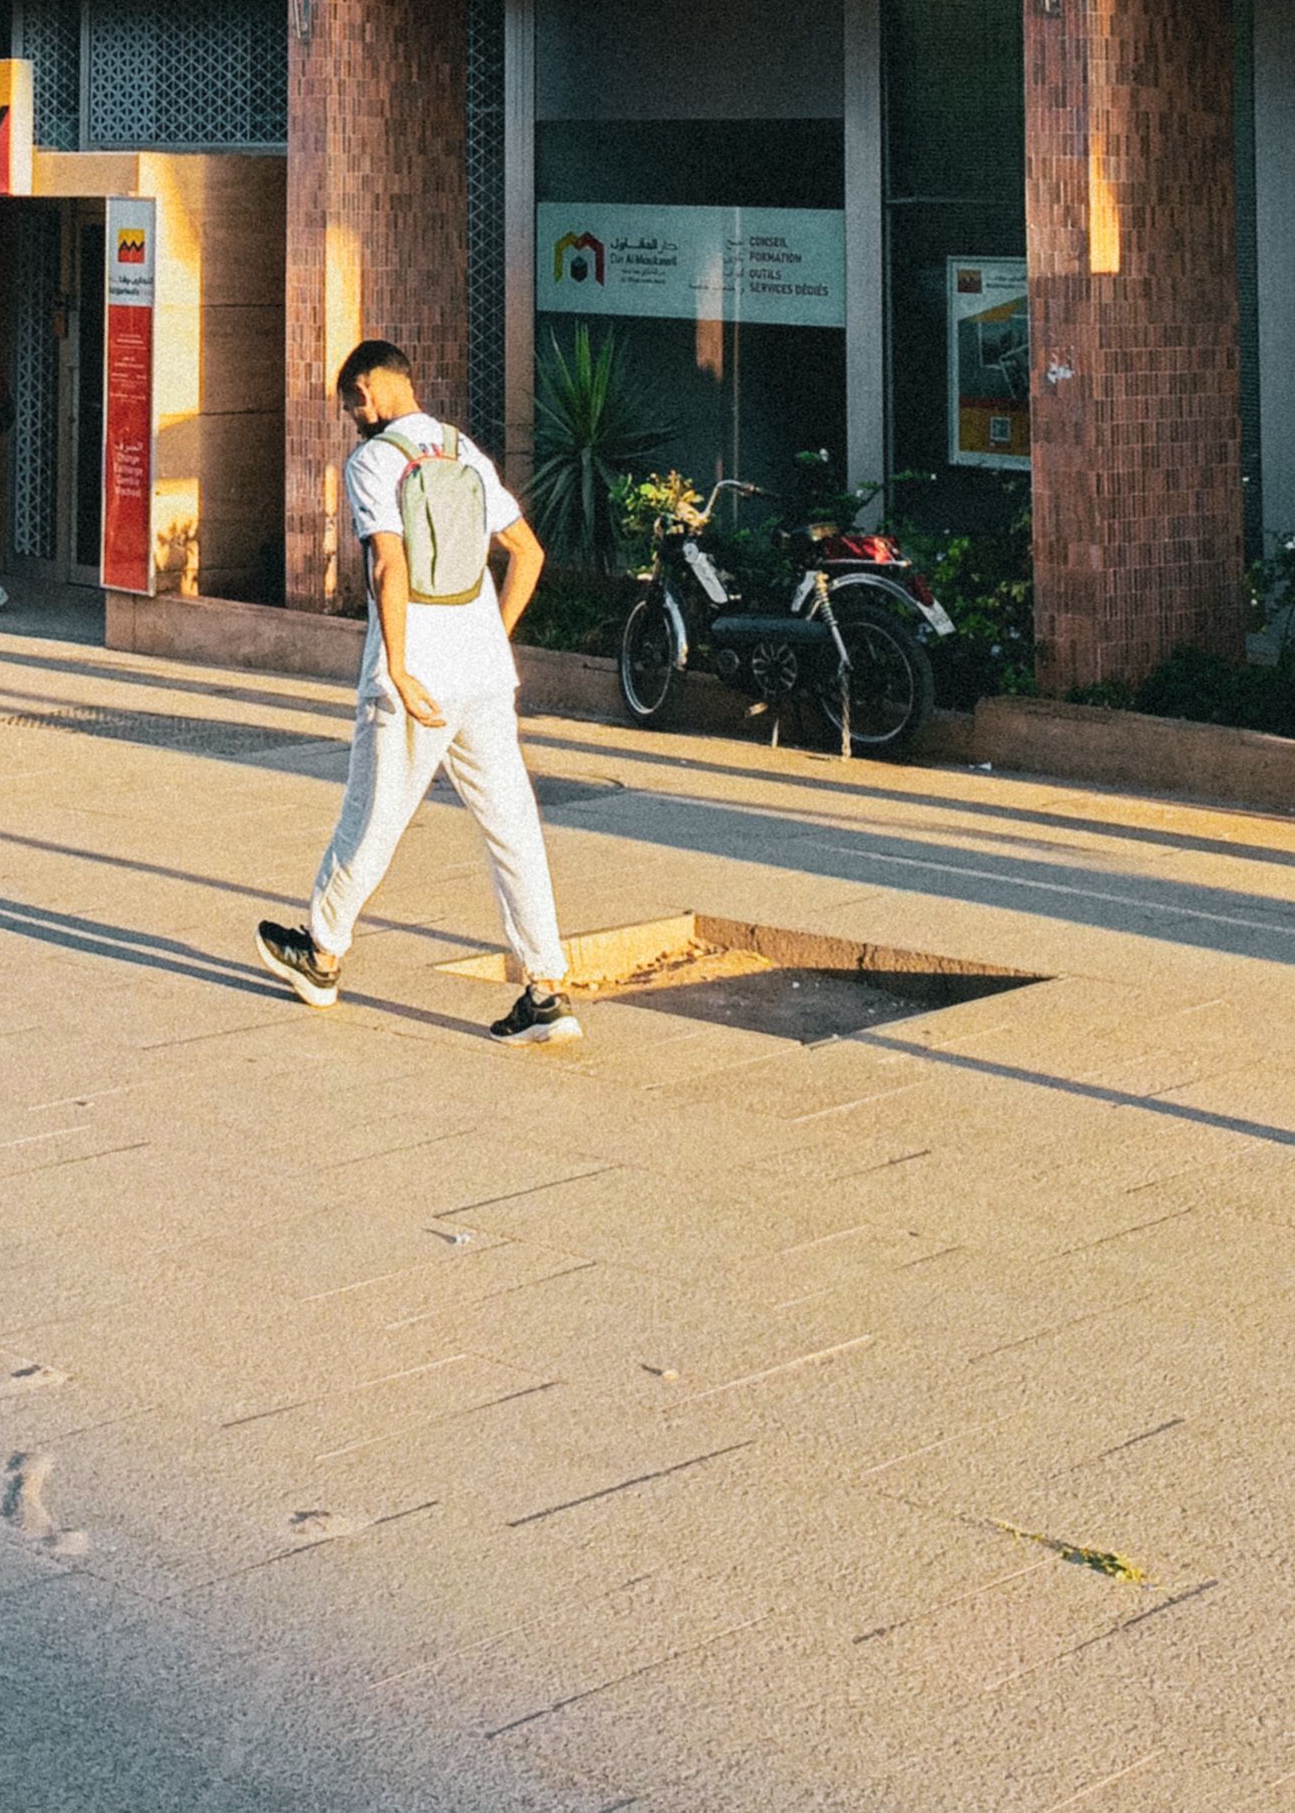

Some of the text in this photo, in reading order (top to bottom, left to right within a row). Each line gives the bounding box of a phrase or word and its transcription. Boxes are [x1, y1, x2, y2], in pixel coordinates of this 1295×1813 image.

[749, 236, 788, 248] CONSEIL
[749, 251, 802, 264] FORMATION
[749, 268, 782, 281] OUTILS
[749, 281, 793, 295] SERVICES
